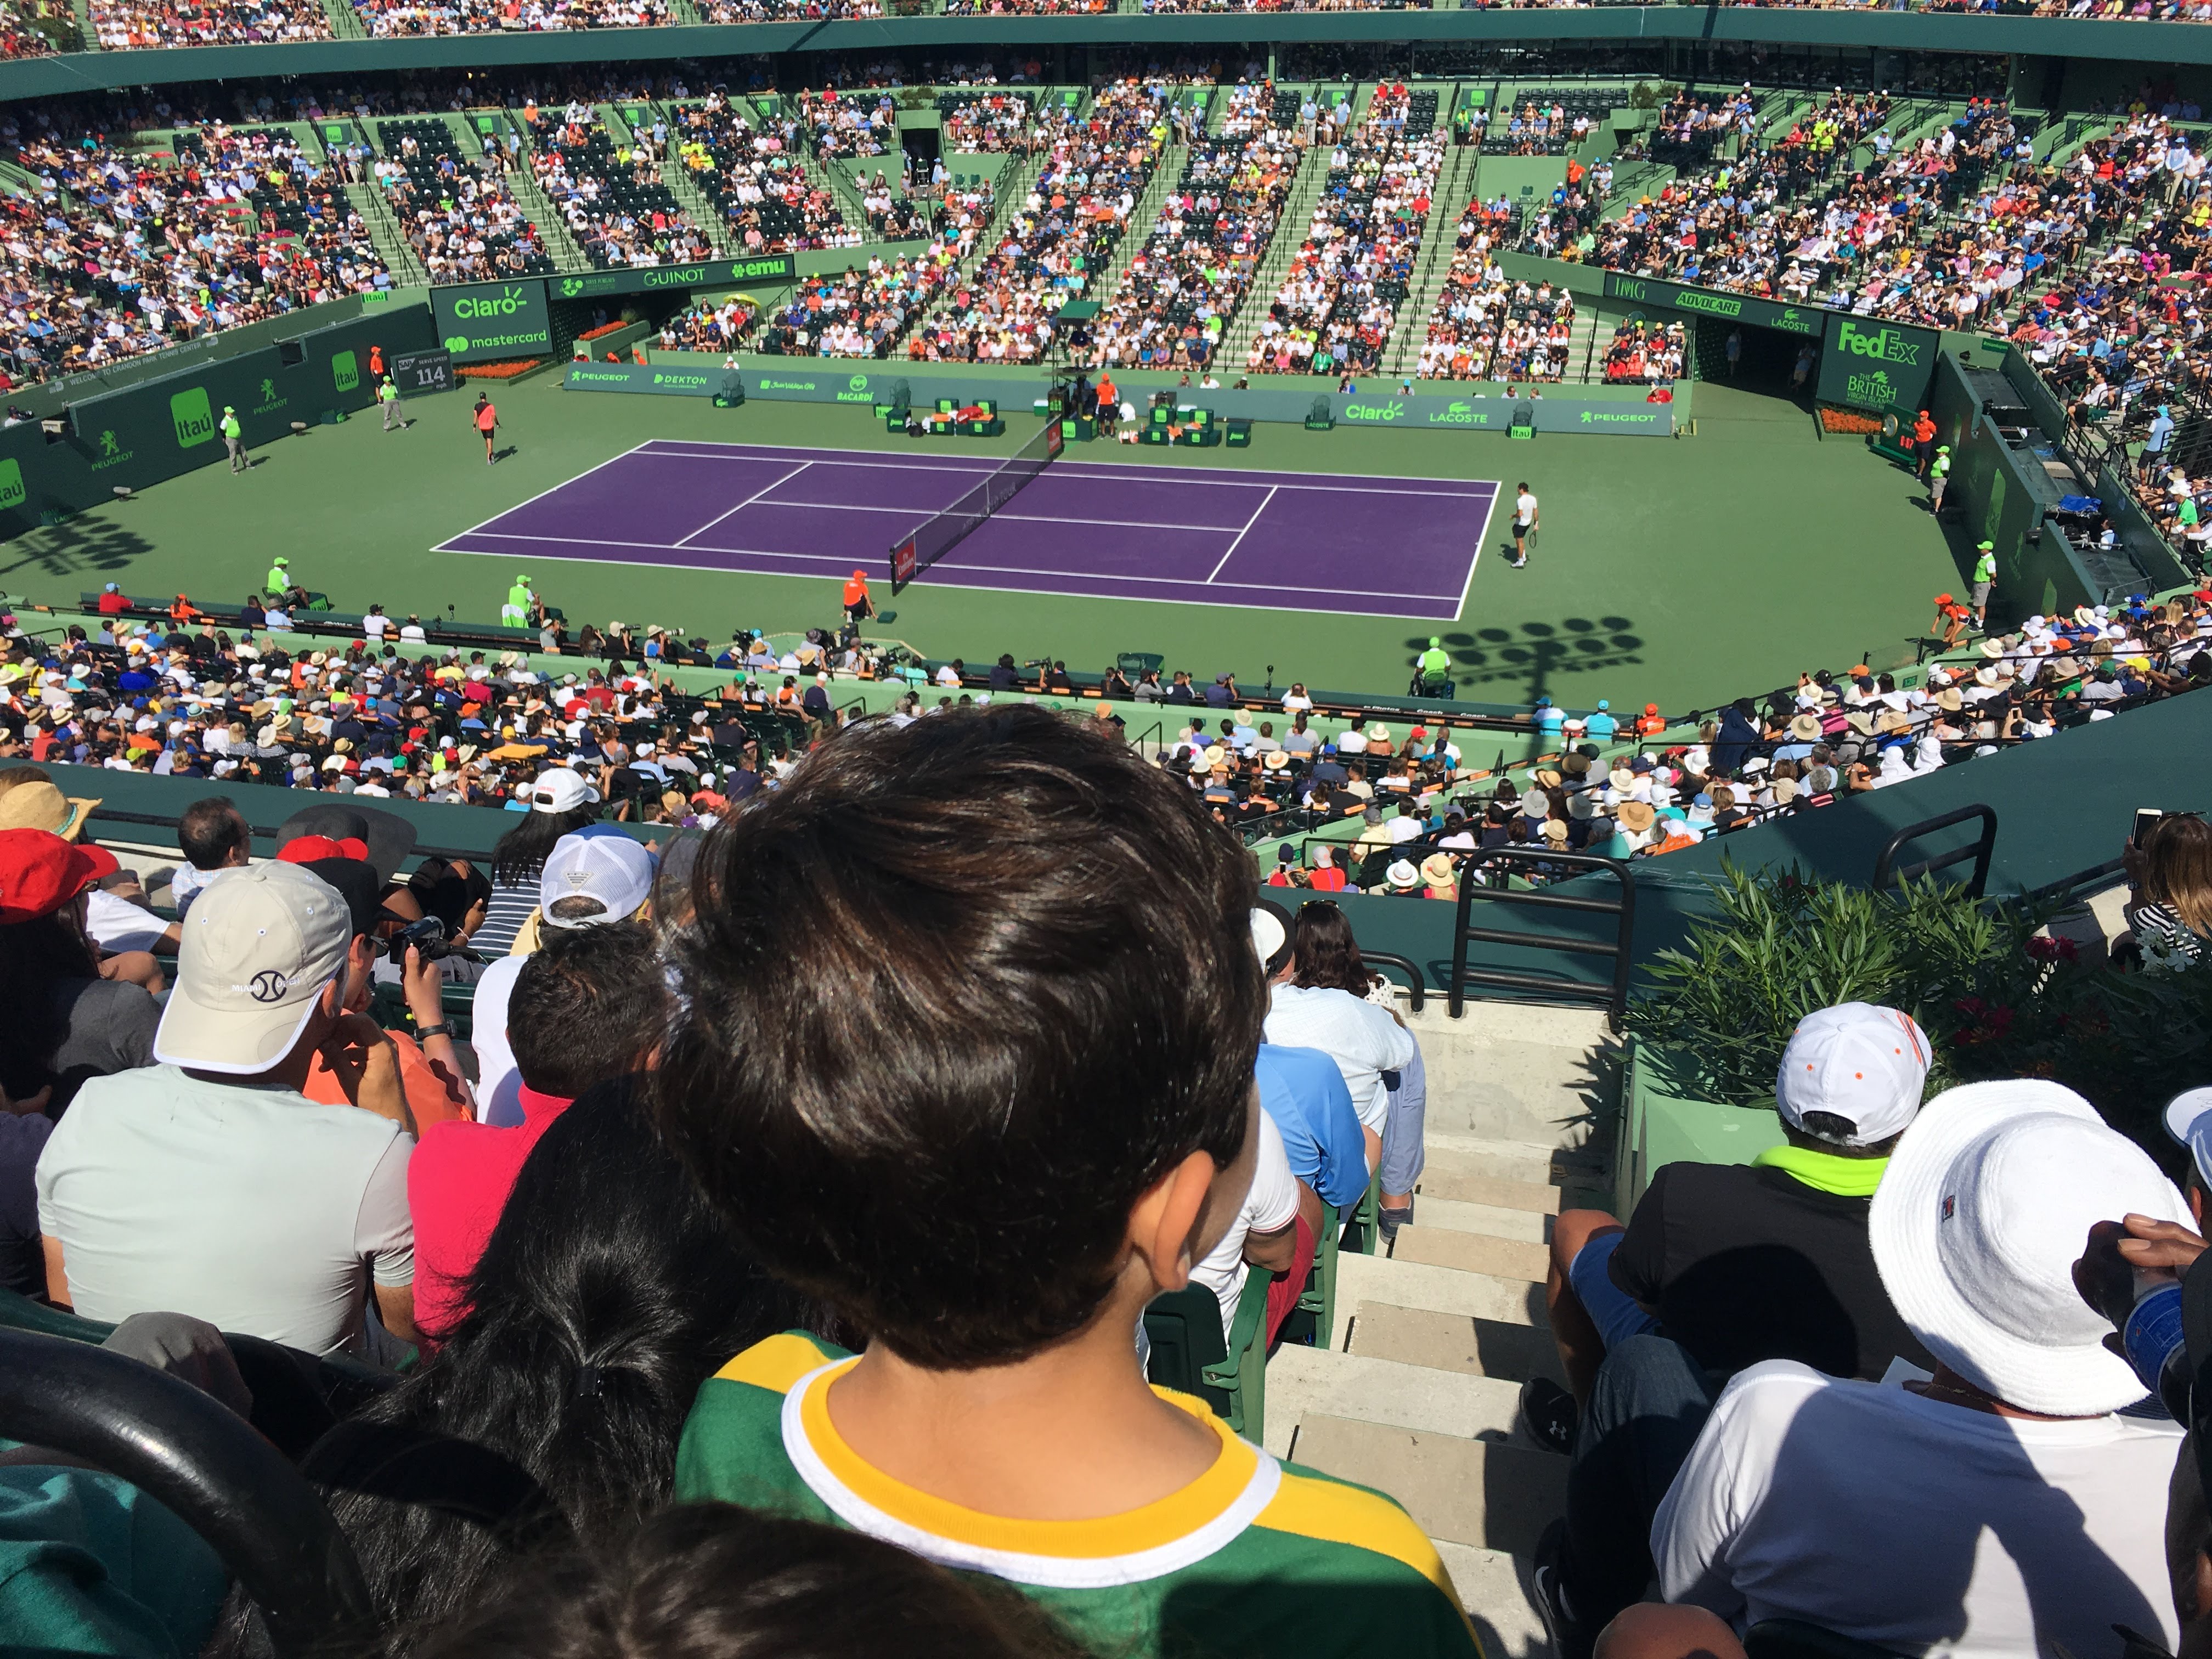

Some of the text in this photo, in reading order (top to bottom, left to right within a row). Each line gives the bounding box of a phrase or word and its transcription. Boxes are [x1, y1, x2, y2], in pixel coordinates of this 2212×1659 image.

[746, 260, 785, 276] emu
[644, 268, 706, 286] GUINOT
[455, 297, 517, 319] Claro
[1677, 294, 1740, 314] ADVOCARE
[1771, 318, 1810, 332] LACOSTE
[472, 330, 546, 348] mastercard
[1838, 321, 1920, 365] FedEx
[112, 360, 141, 373] CRANDON
[142, 356, 157, 365] PARK
[159, 350, 179, 360] TENNIS
[179, 342, 202, 354] CENTER
[398, 360, 413, 370] SAP
[336, 368, 357, 386] Itaú
[416, 366, 445, 385] 114
[582, 373, 630, 381] PEUGEOT
[664, 375, 707, 384] DEKTON
[1848, 375, 1897, 400] BRITISH
[1847, 391, 1894, 404] VIRGIN ISLAN
[253, 398, 287, 415] PEUGEOT
[1346, 404, 1396, 420] Claro
[178, 413, 212, 439] Itaú
[1430, 413, 1488, 423] LACOSTE
[1594, 414, 1656, 422] PEUGEOT
[92, 451, 133, 472] PEUGEOT
[232, 977, 301, 992] MIAMI OPEN
